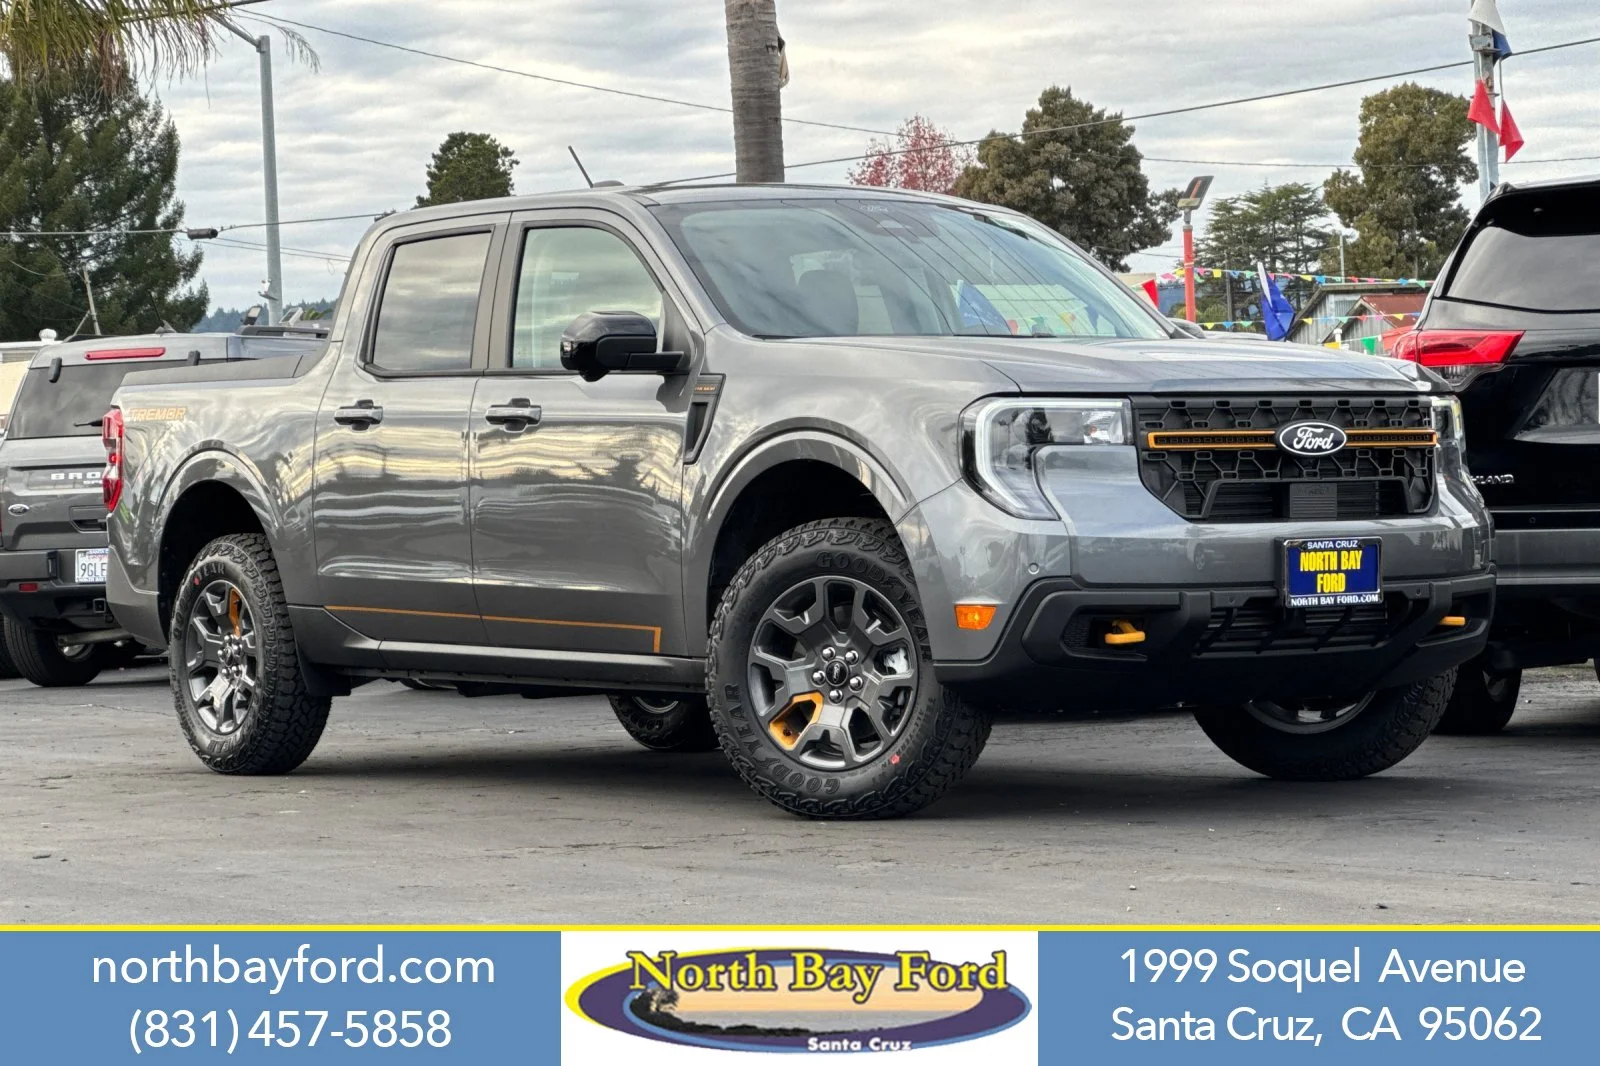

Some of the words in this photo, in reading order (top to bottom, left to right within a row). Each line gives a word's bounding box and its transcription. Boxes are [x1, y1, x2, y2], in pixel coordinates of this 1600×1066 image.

[128, 407, 186, 421] TREMOR
[1292, 427, 1335, 449] Ford
[50, 472, 101, 480] BRO
[1469, 474, 1514, 484] HLAND
[1307, 541, 1334, 549] SANTA
[1335, 540, 1358, 548] CRUZ
[1300, 551, 1338, 572] NORTH
[1341, 550, 1363, 570] BAY
[81, 562, 107, 578] 9GLE
[1316, 572, 1346, 593] FORD
[1291, 597, 1318, 606] NORTH
[1320, 596, 1335, 605] BAY
[724, 683, 840, 795] GOODYEAR
